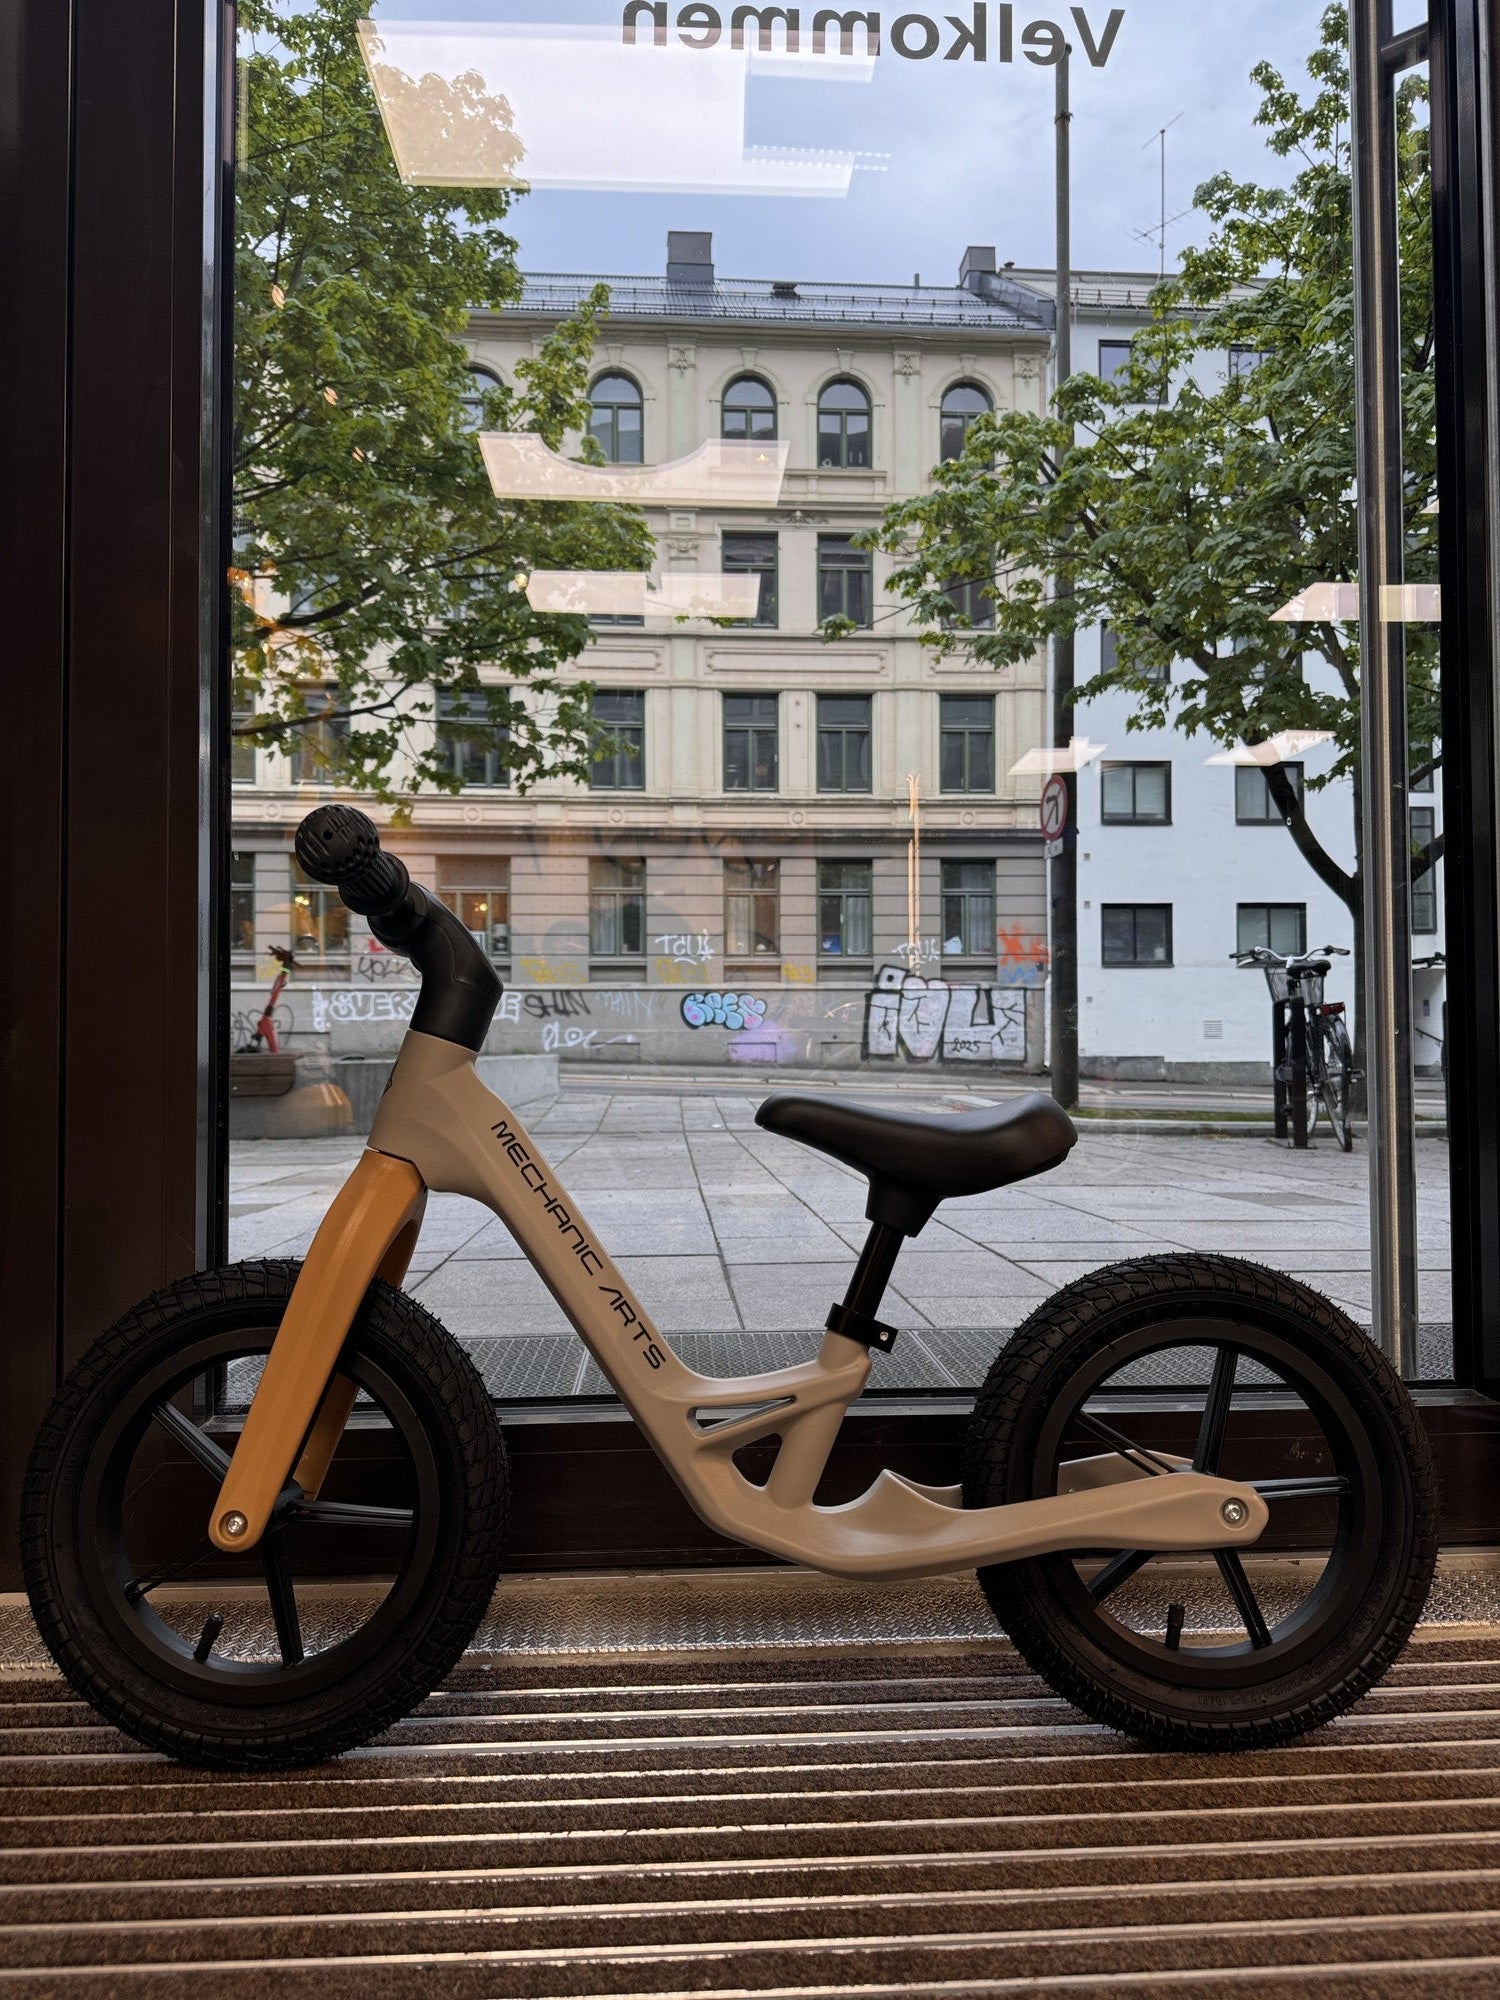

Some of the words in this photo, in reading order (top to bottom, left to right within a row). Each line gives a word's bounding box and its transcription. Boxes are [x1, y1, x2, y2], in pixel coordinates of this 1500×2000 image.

[951, 1037, 981, 1055] 2025
[491, 1120, 603, 1276] MECHANIC
[598, 1285, 666, 1370] ARTS
